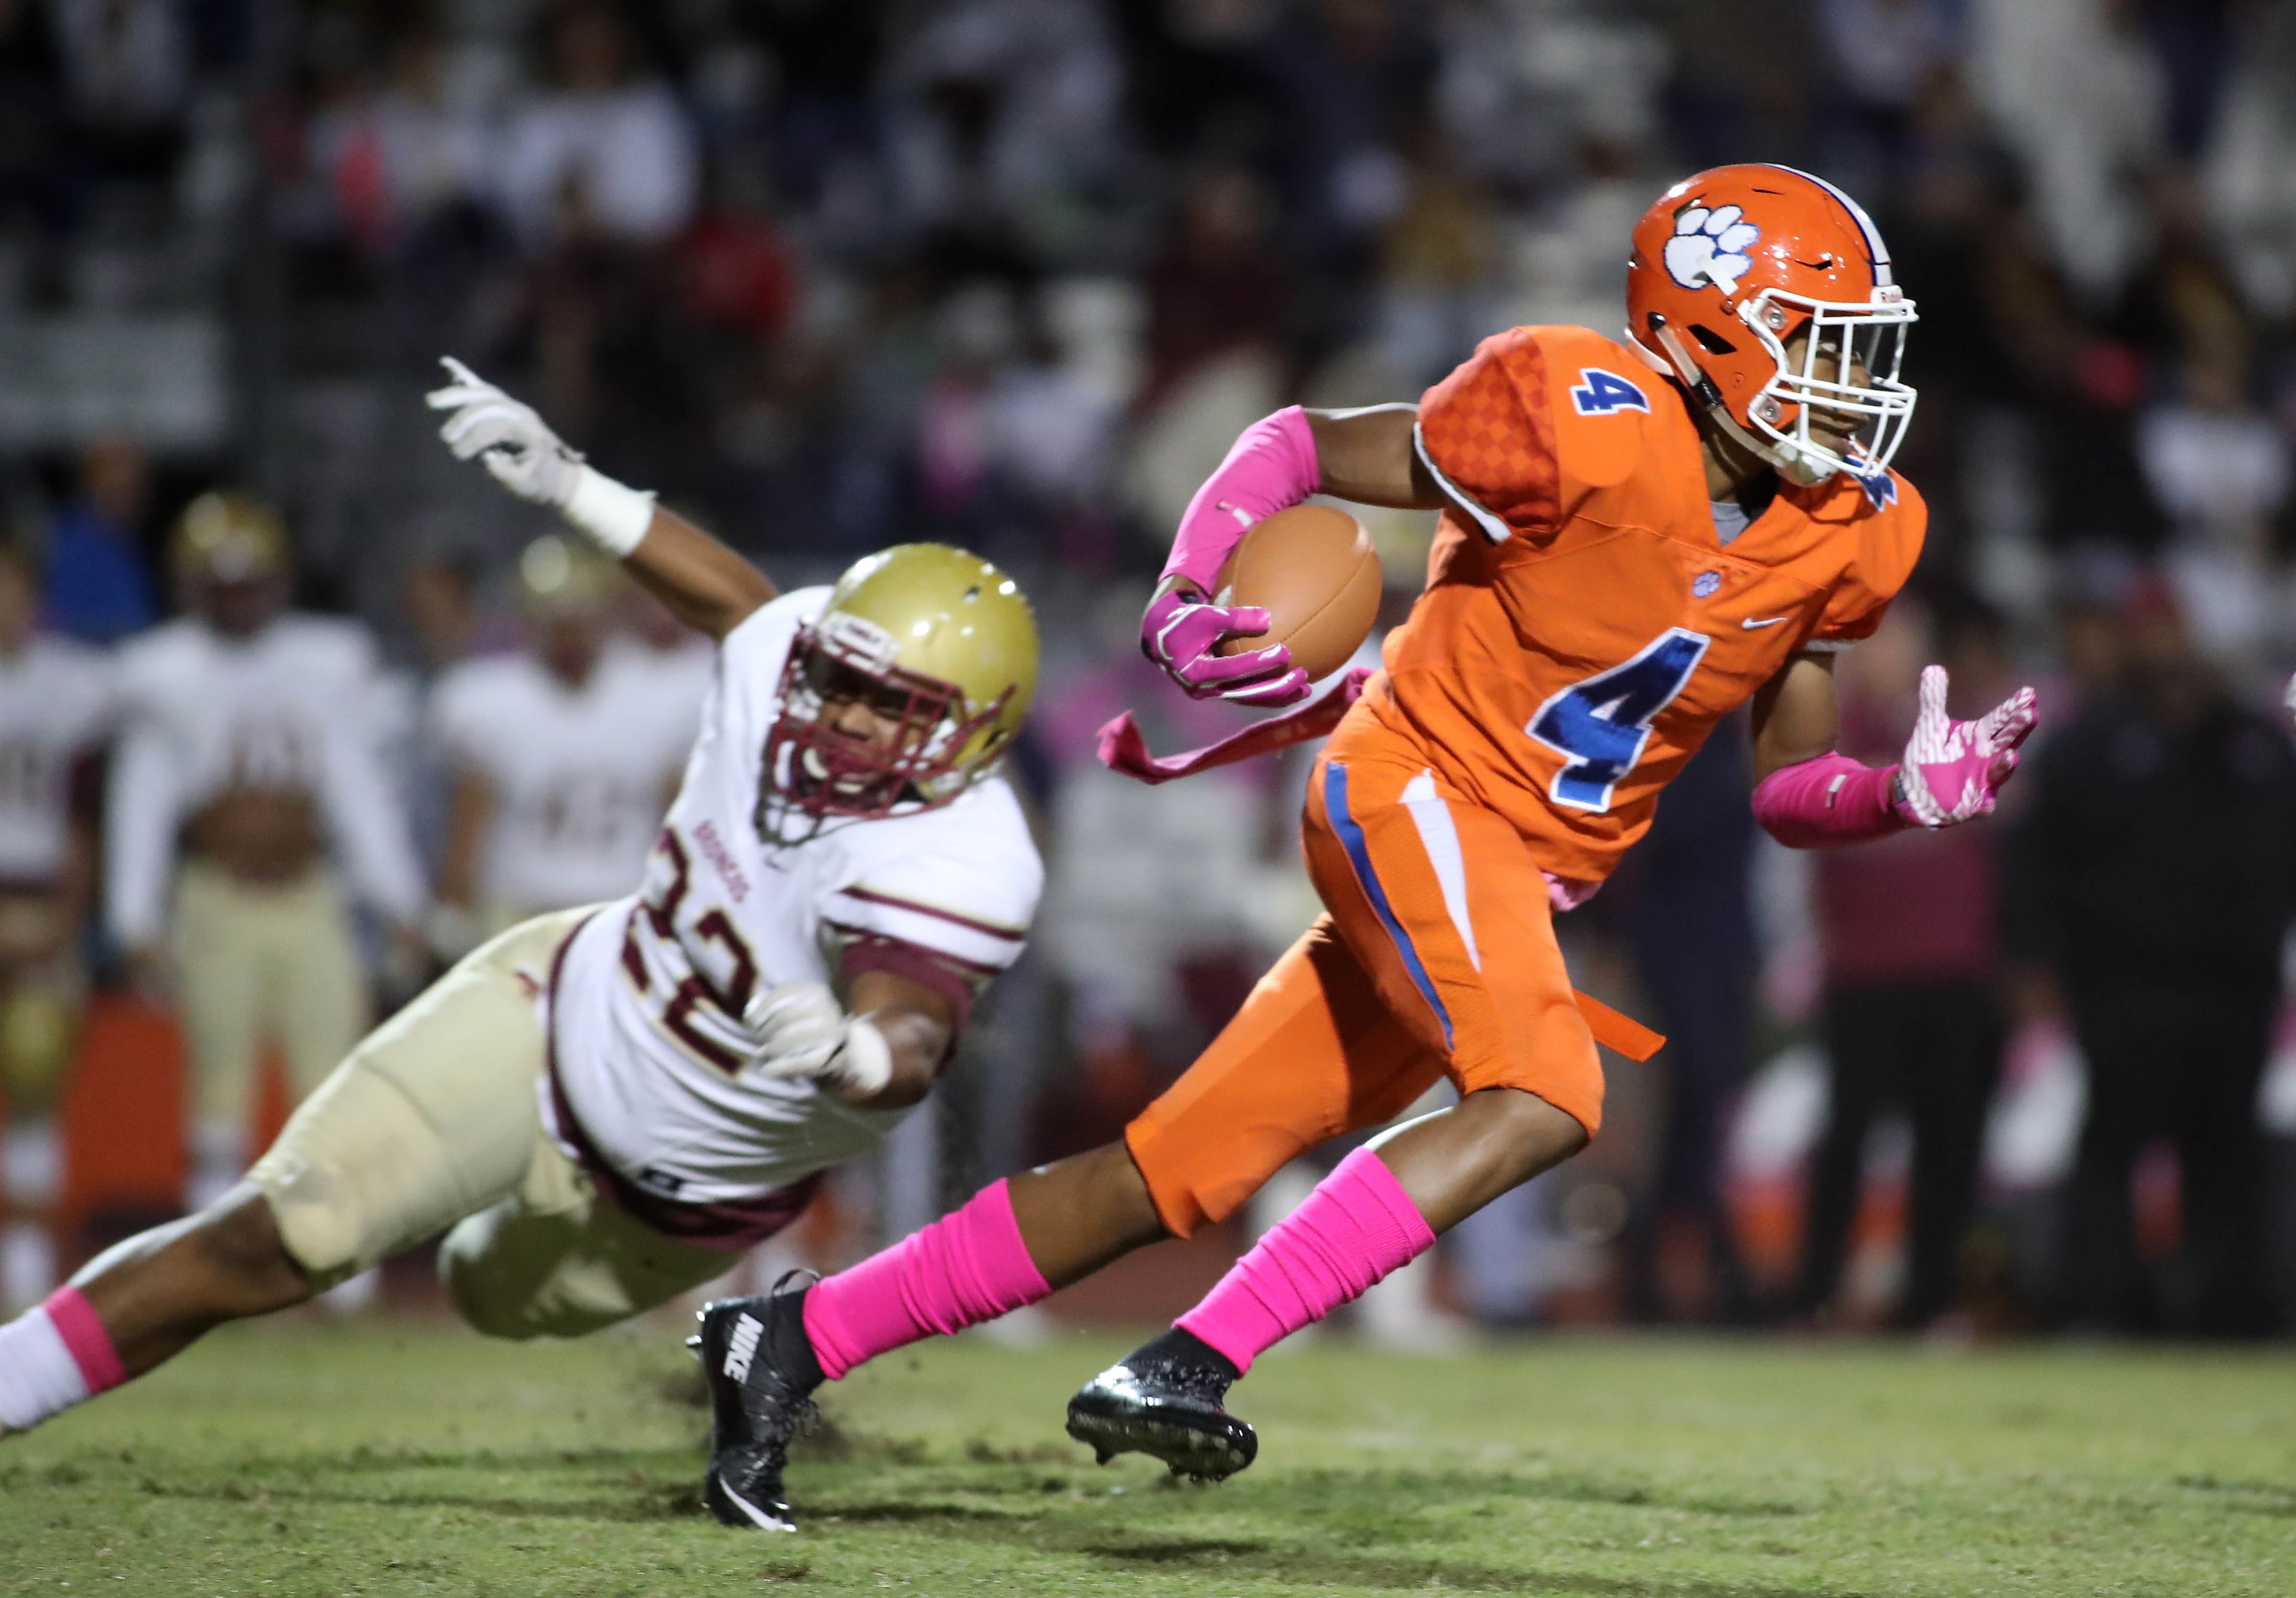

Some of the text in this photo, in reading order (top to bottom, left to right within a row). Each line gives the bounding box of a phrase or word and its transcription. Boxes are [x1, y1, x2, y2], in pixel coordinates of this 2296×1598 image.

[1570, 367, 1651, 416] 4
[1524, 626, 1711, 813] 4
[723, 1312, 765, 1384] NIKE
